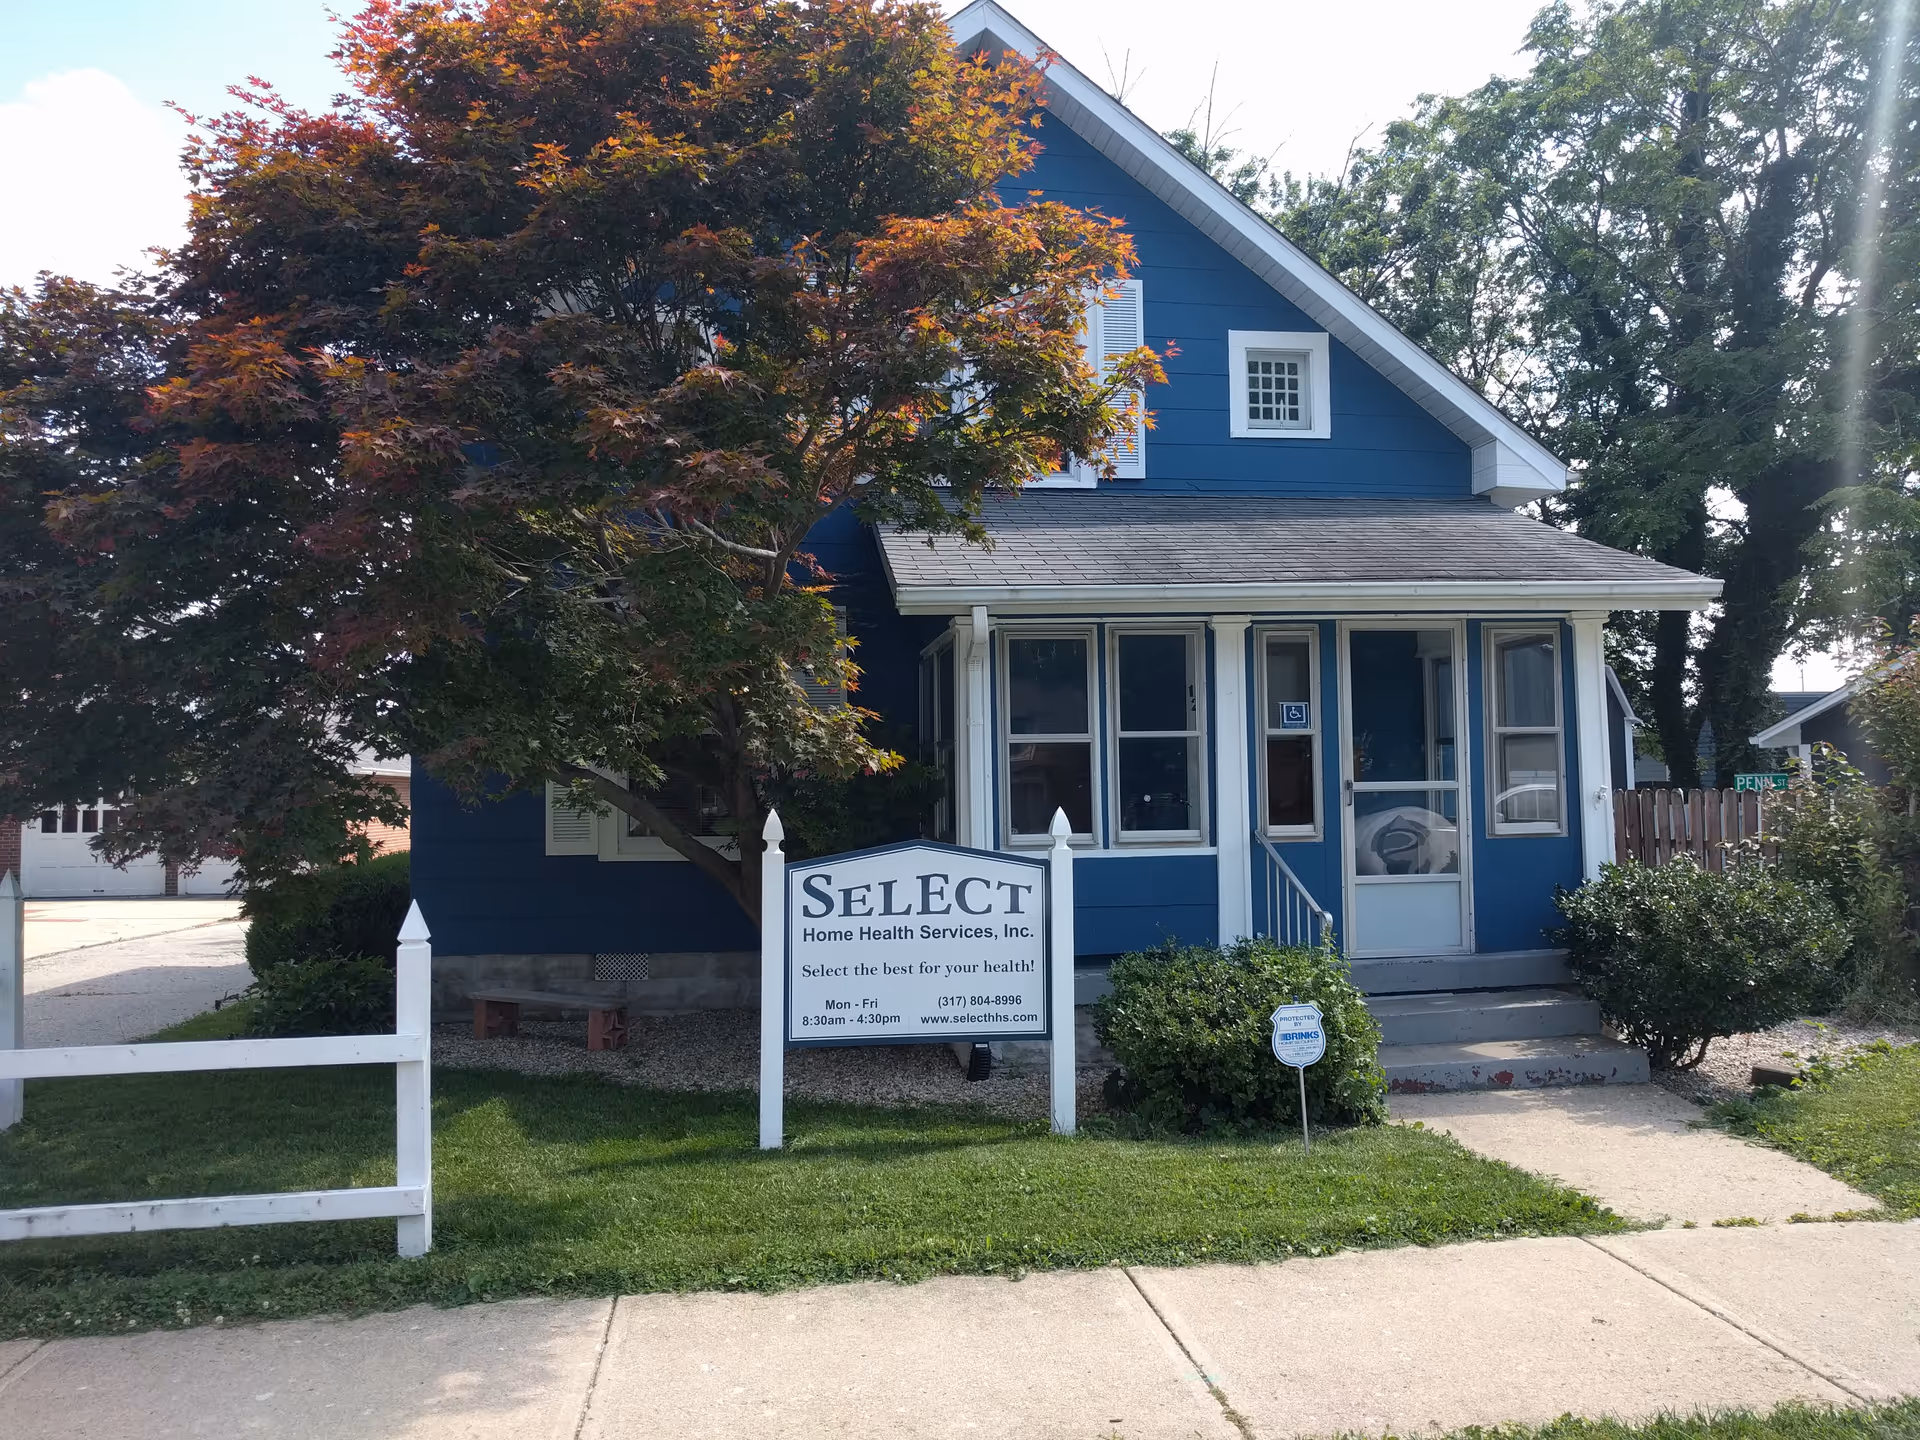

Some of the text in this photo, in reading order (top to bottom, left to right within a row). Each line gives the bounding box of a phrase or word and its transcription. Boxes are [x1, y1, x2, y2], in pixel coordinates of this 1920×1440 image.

[1777, 778, 1786, 787] ST
[802, 873, 1033, 919] SELECT
[803, 923, 1034, 942] Home Health Services, Inc.
[802, 959, 1035, 978] Select the best for your health!
[825, 999, 851, 1010] Mon
[862, 998, 878, 1009] Fri
[937, 994, 1022, 1009] (317) 804-8996
[802, 1015, 846, 1027] 8:30am
[857, 1013, 901, 1026] 4:30pm
[920, 1012, 1038, 1024] www.selecthhs.com
[1285, 1031, 1319, 1040] BRINKS
